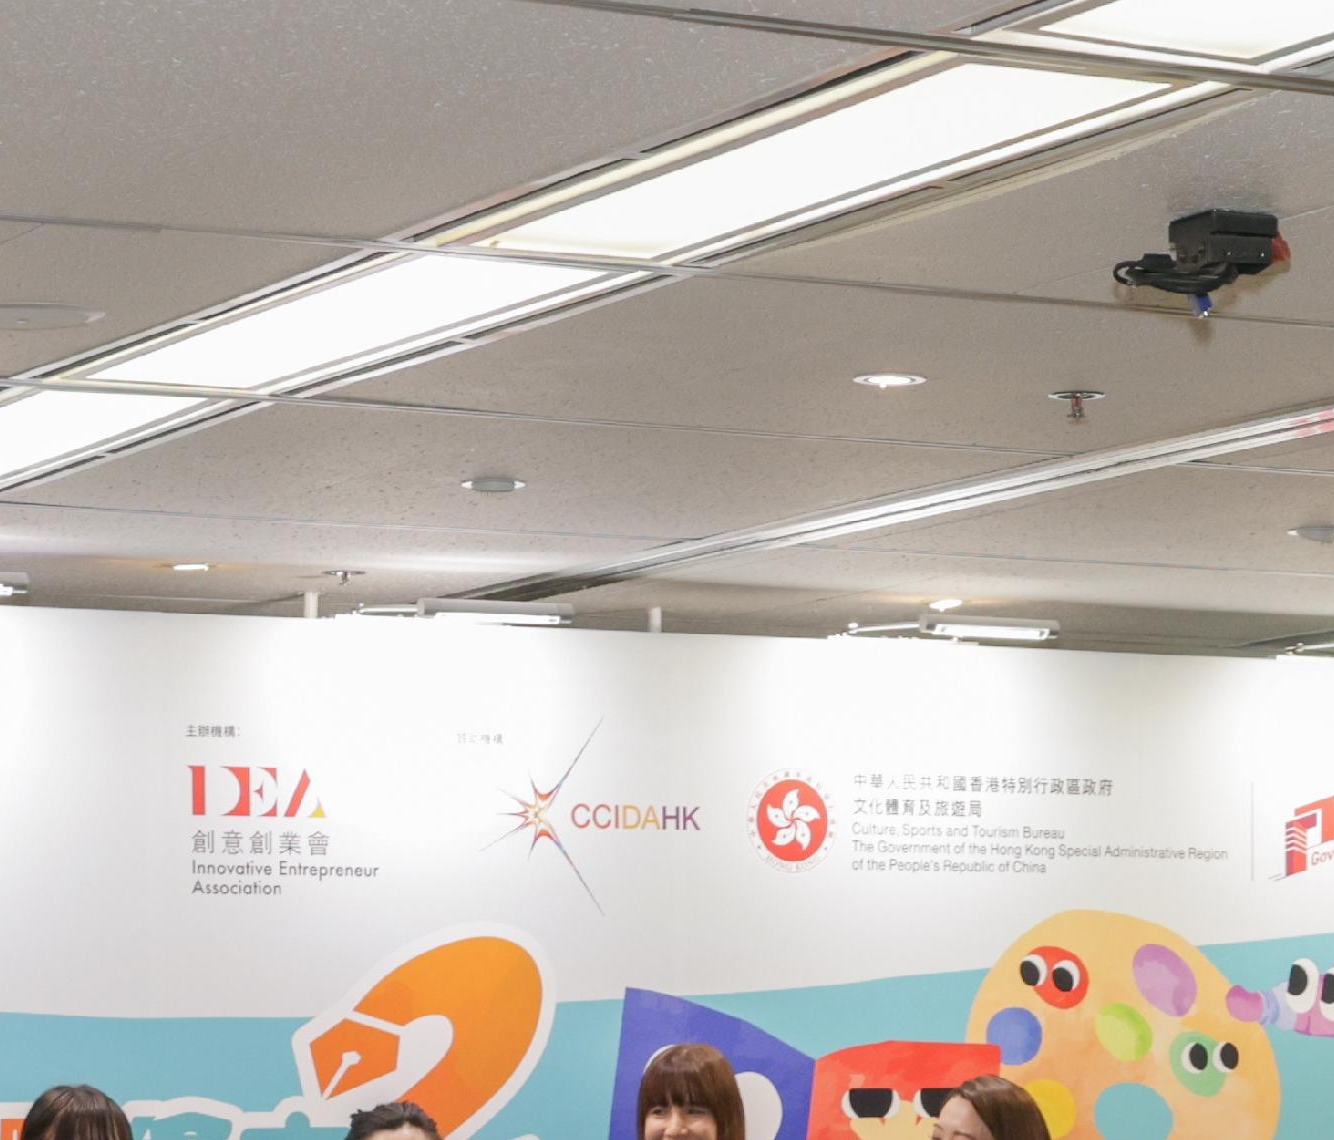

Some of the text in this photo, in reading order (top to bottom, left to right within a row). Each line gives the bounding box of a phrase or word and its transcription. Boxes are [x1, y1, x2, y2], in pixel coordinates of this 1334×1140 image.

[854, 774, 1113, 796] 中華人民共和國香港特別行政區政府
[571, 803, 701, 831] CCIDAHK
[853, 799, 982, 818] 文化體育及旅遊局
[852, 822, 1065, 840] Culture, Sports and Tourism Bureau
[192, 829, 330, 856] 創意創業會
[852, 839, 1228, 863] The Government of the Hong Kong Special Administrative Region
[192, 860, 379, 880] Innovative Entrepreneur
[851, 858, 1046, 874] of the People's Republic of China
[192, 880, 282, 896] Association
